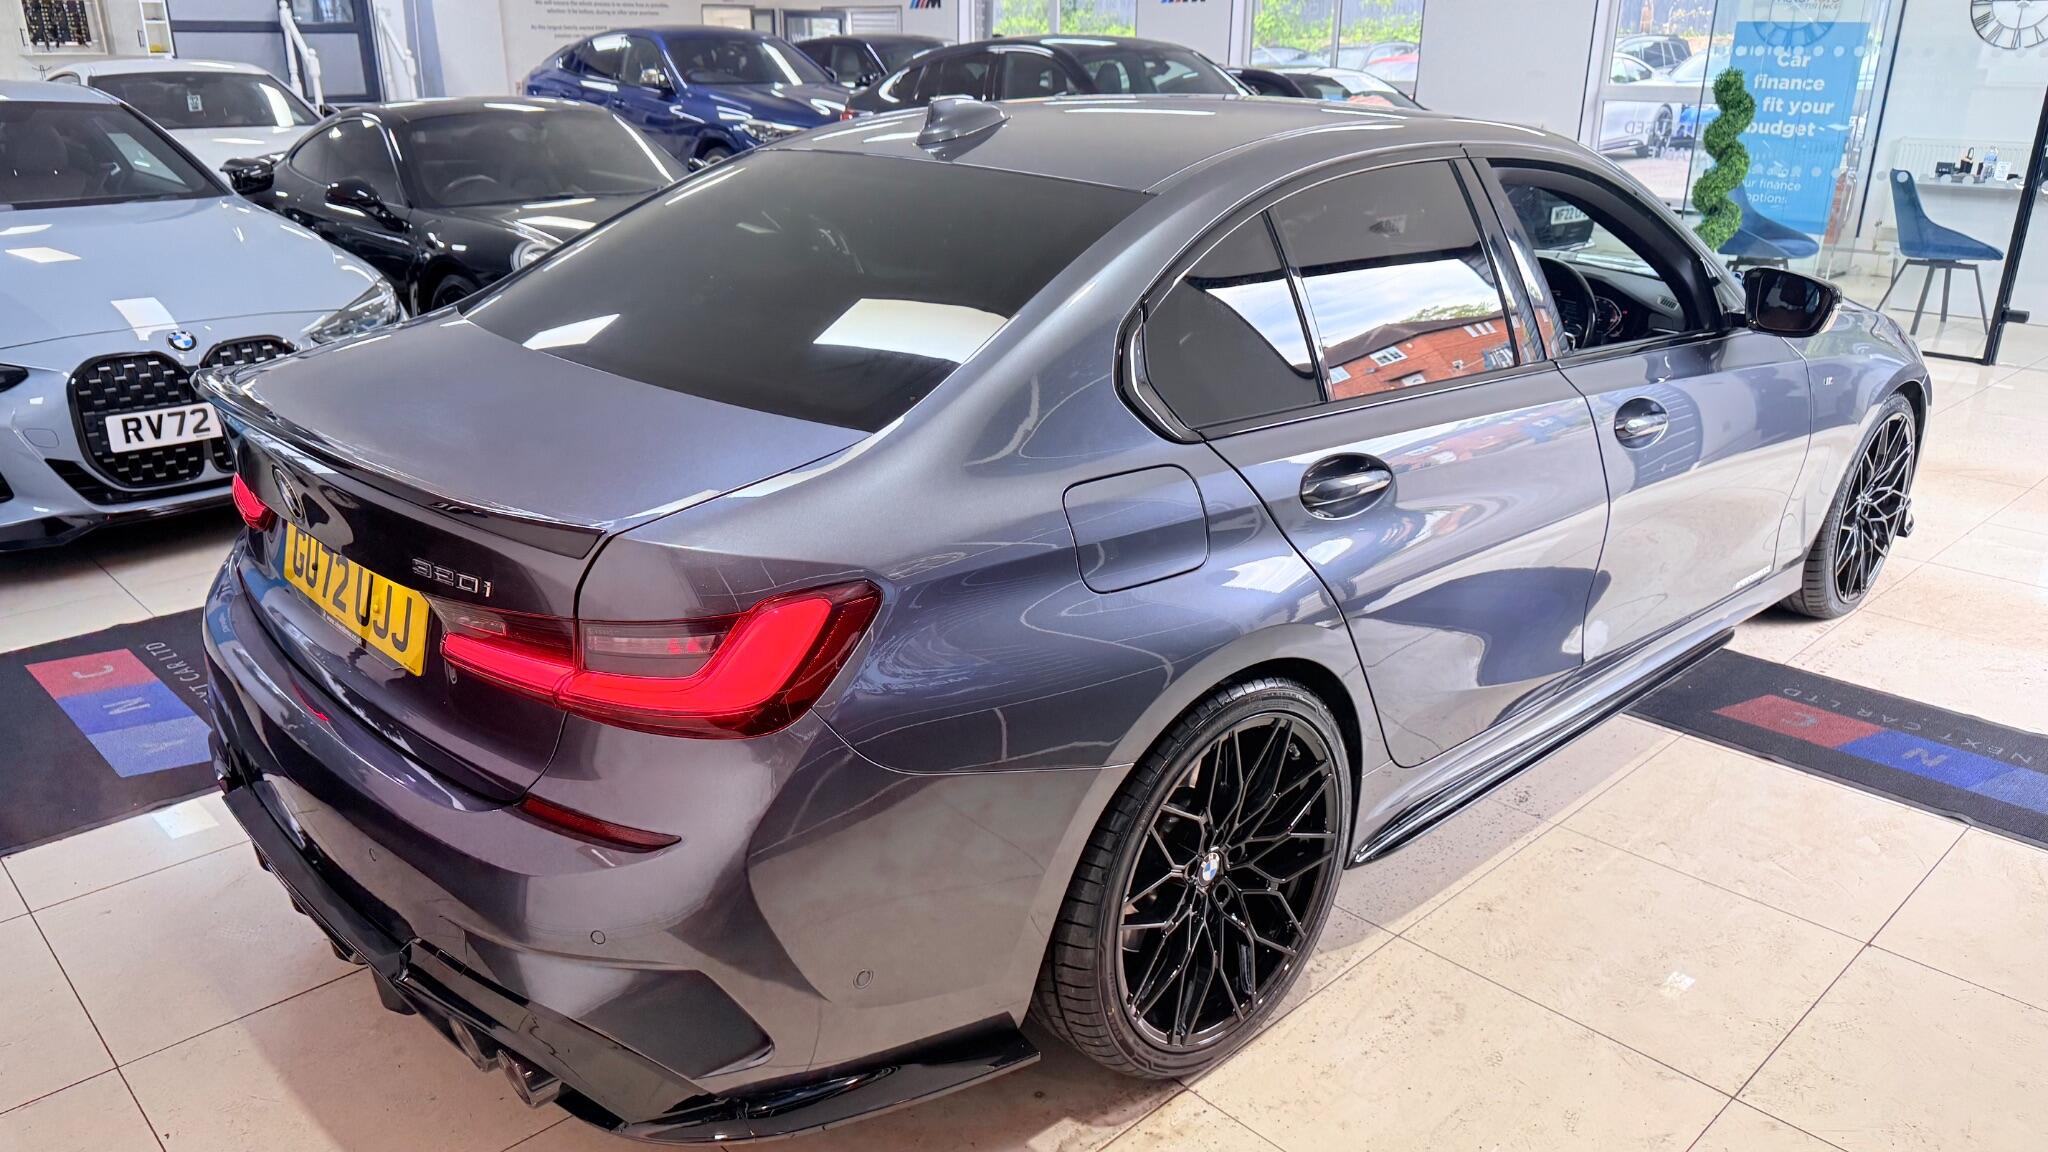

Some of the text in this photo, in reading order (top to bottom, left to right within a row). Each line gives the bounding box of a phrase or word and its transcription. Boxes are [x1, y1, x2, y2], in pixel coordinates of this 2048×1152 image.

[1777, 52, 1811, 67] Car
[1754, 74, 1825, 91] finance
[1762, 96, 1835, 116] fit your
[1759, 179, 1801, 191] finance
[121, 407, 211, 444] RV72
[412, 557, 493, 597] 320i
[355, 565, 412, 652] UJJ
[145, 641, 178, 662] LTD
[166, 660, 200, 683] CAR
[1783, 688, 2032, 764] NEXT CAR LTD
